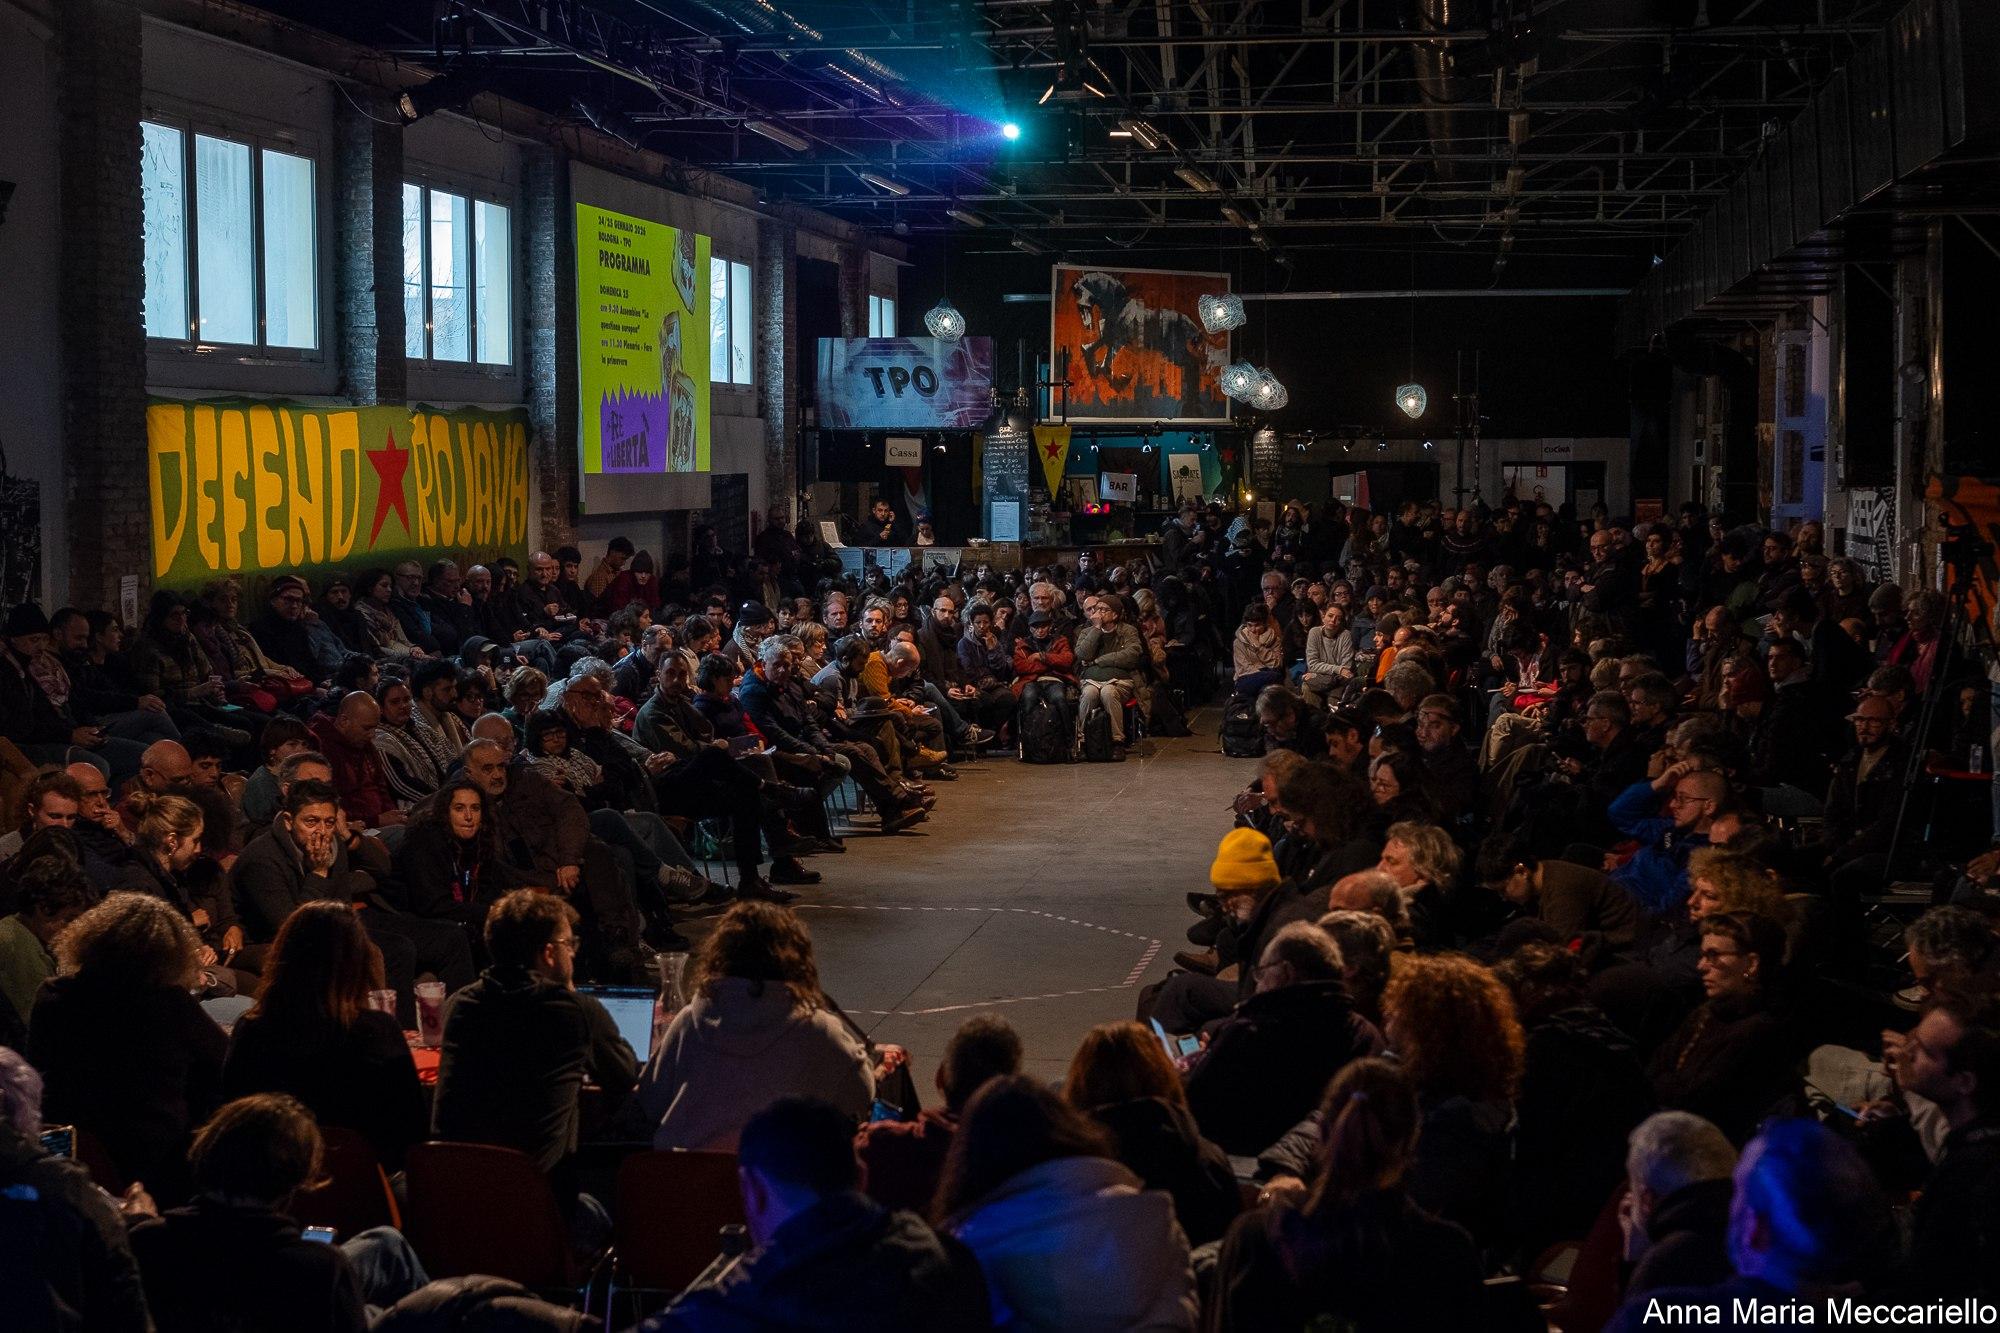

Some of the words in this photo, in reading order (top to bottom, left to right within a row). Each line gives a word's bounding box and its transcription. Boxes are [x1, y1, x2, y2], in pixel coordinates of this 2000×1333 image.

[614, 220, 634, 232] GENNAIO
[598, 231, 619, 245] BOLOGNA
[623, 237, 632, 248] TPO
[599, 249, 651, 276] PROGRAMMA
[599, 284, 622, 298] DOMENICA
[863, 365, 940, 398] TPO
[889, 446, 918, 458] Cassa
[147, 404, 360, 578] DEFEND
[409, 414, 529, 548] ROJAVA
[1109, 481, 1128, 491] BAR
